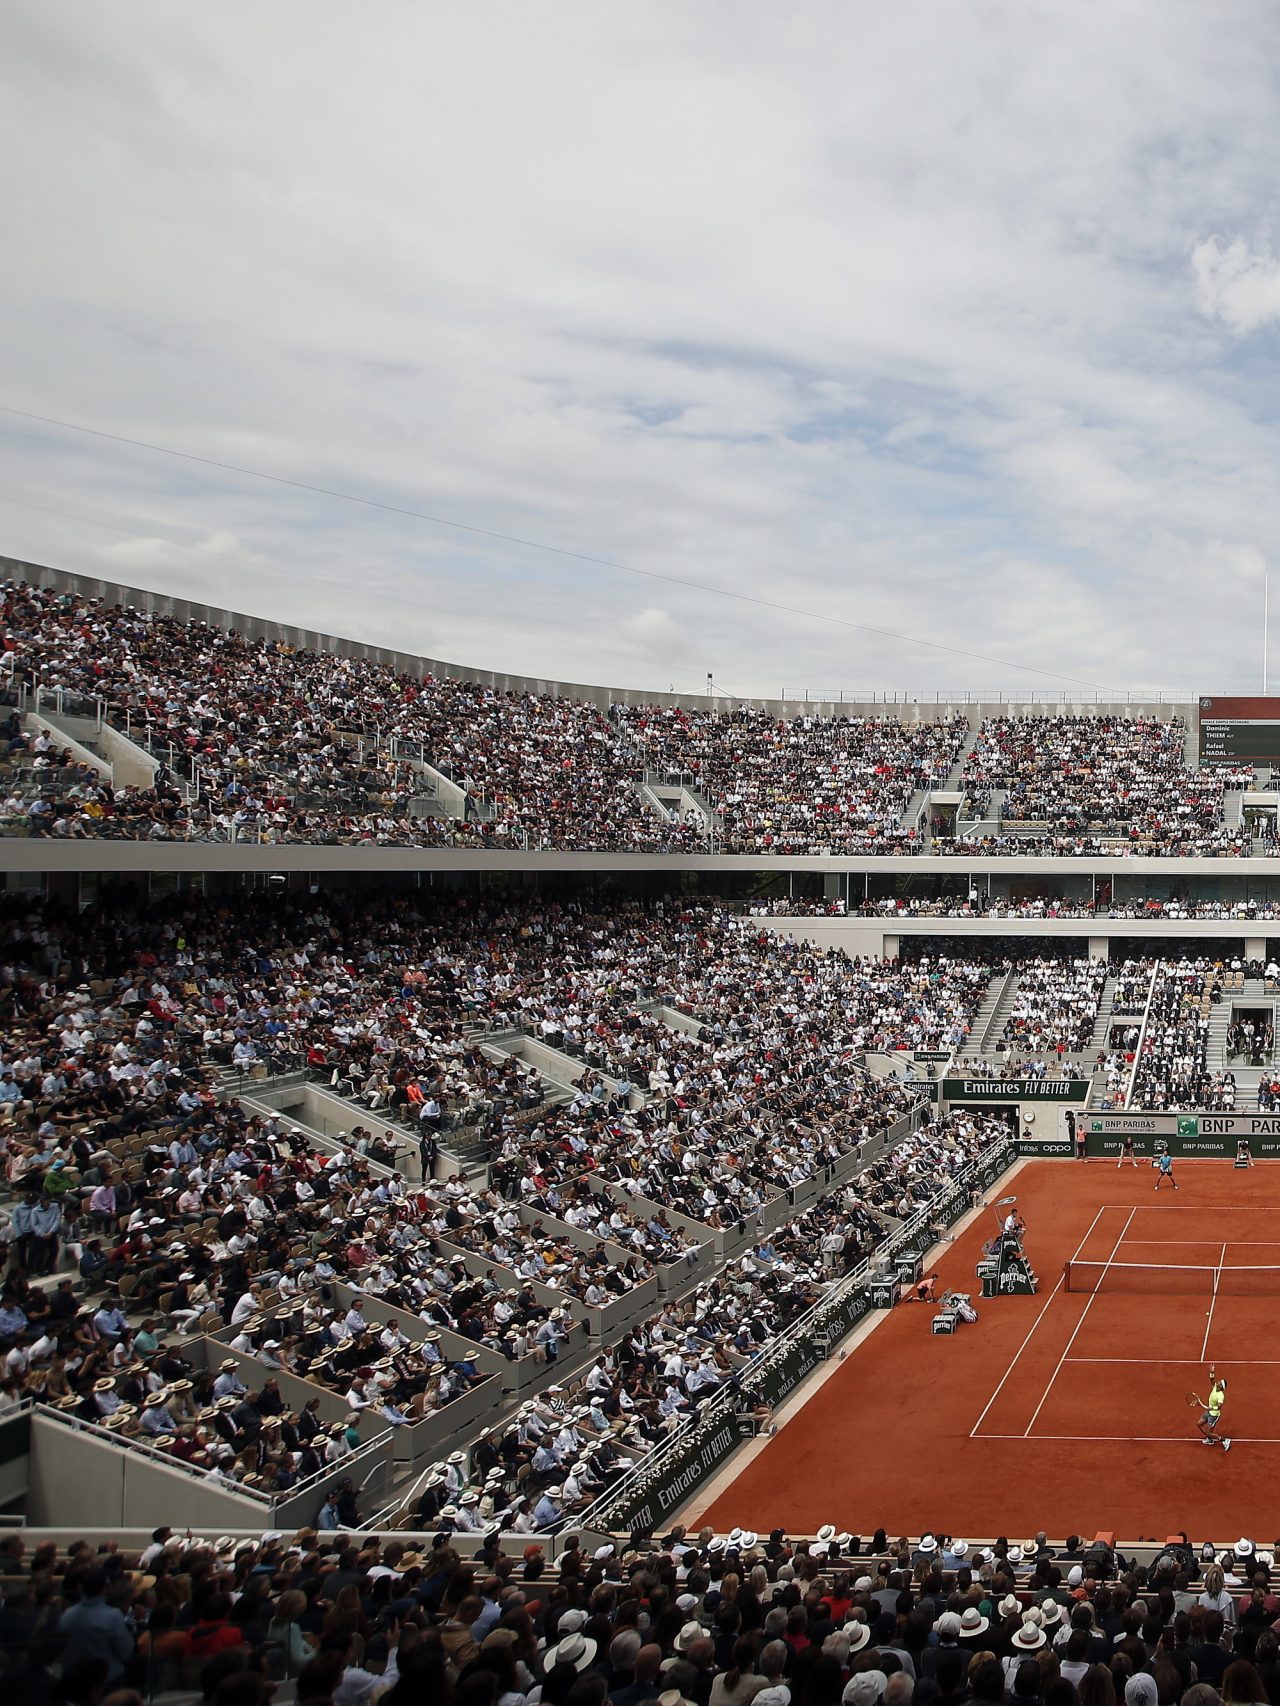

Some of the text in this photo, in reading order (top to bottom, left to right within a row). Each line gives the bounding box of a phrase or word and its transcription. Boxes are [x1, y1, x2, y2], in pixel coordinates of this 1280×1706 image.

[963, 1081, 1070, 1094] Emirates FLY BETTER
[1105, 1120, 1156, 1128] BNP PARIBAS
[1202, 1119, 1234, 1133] BNP
[1042, 1144, 1071, 1153] oppo
[951, 1196, 966, 1214] oppo
[1000, 1272, 1026, 1290] perrier
[657, 1426, 733, 1510] Emirates FLY BETTER
